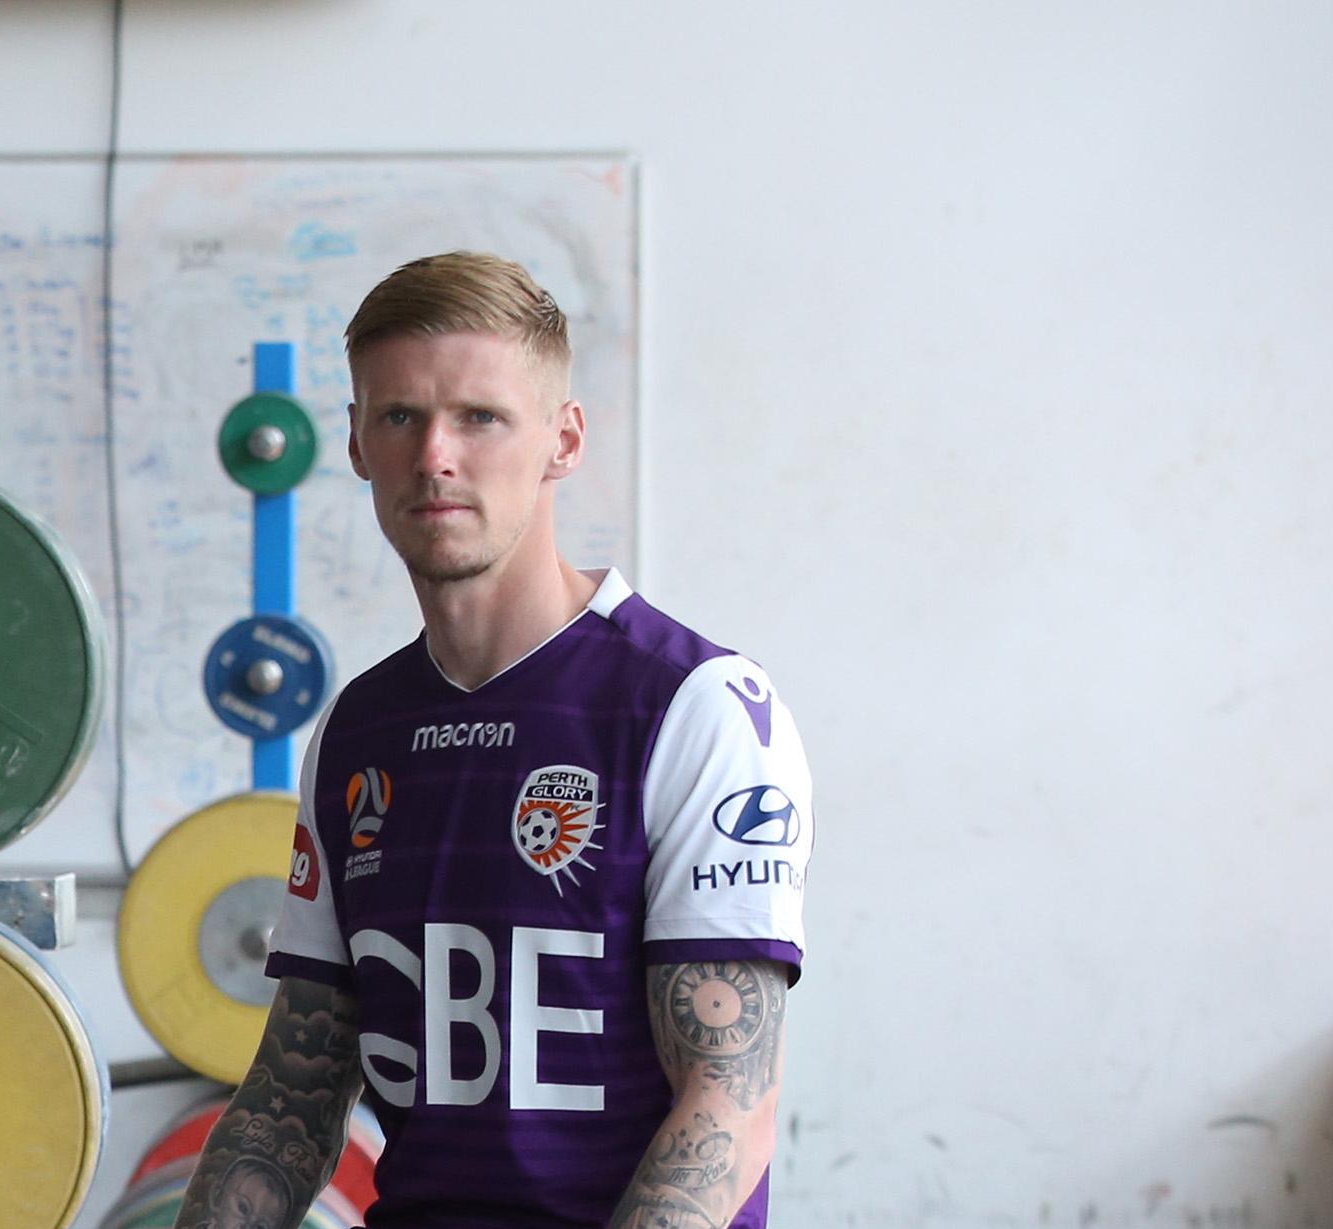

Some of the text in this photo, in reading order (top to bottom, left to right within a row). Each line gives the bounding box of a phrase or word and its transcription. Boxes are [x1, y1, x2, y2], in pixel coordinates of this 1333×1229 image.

[412, 720, 515, 753] macron
[537, 771, 588, 787] PERTH
[531, 786, 587, 800] GLORY
[350, 923, 605, 1112] QBE
